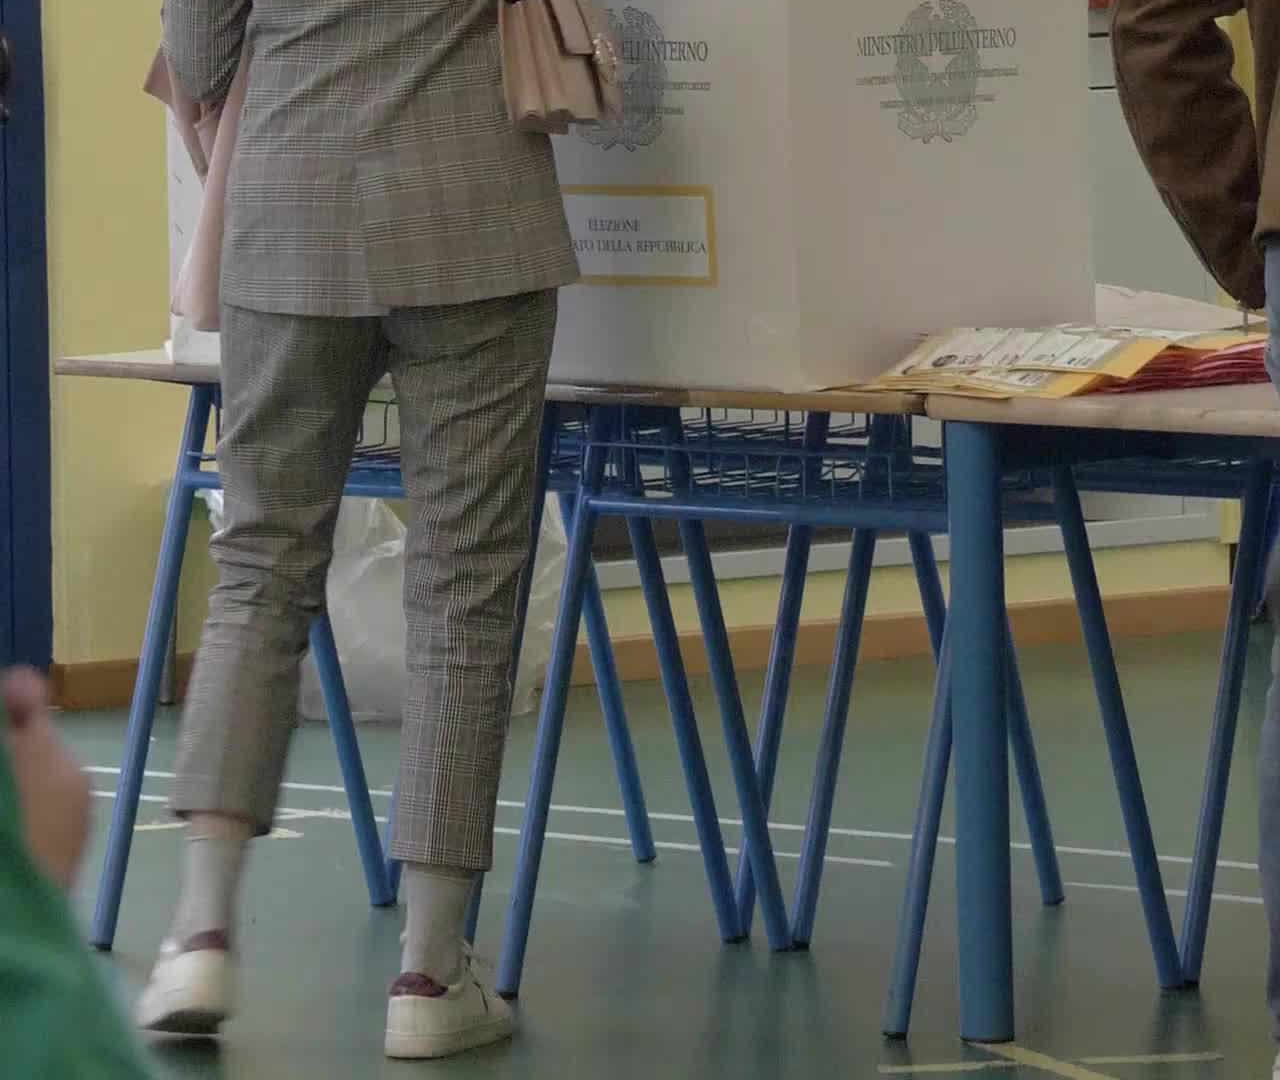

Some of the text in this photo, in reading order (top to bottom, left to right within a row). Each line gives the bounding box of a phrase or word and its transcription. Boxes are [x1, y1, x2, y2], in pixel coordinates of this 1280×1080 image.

[620, 39, 709, 62] ELL'INTERNO
[856, 33, 926, 56] MINISTERO
[598, 239, 633, 253] DELLA
[635, 240, 707, 254] REPUBBLICA
